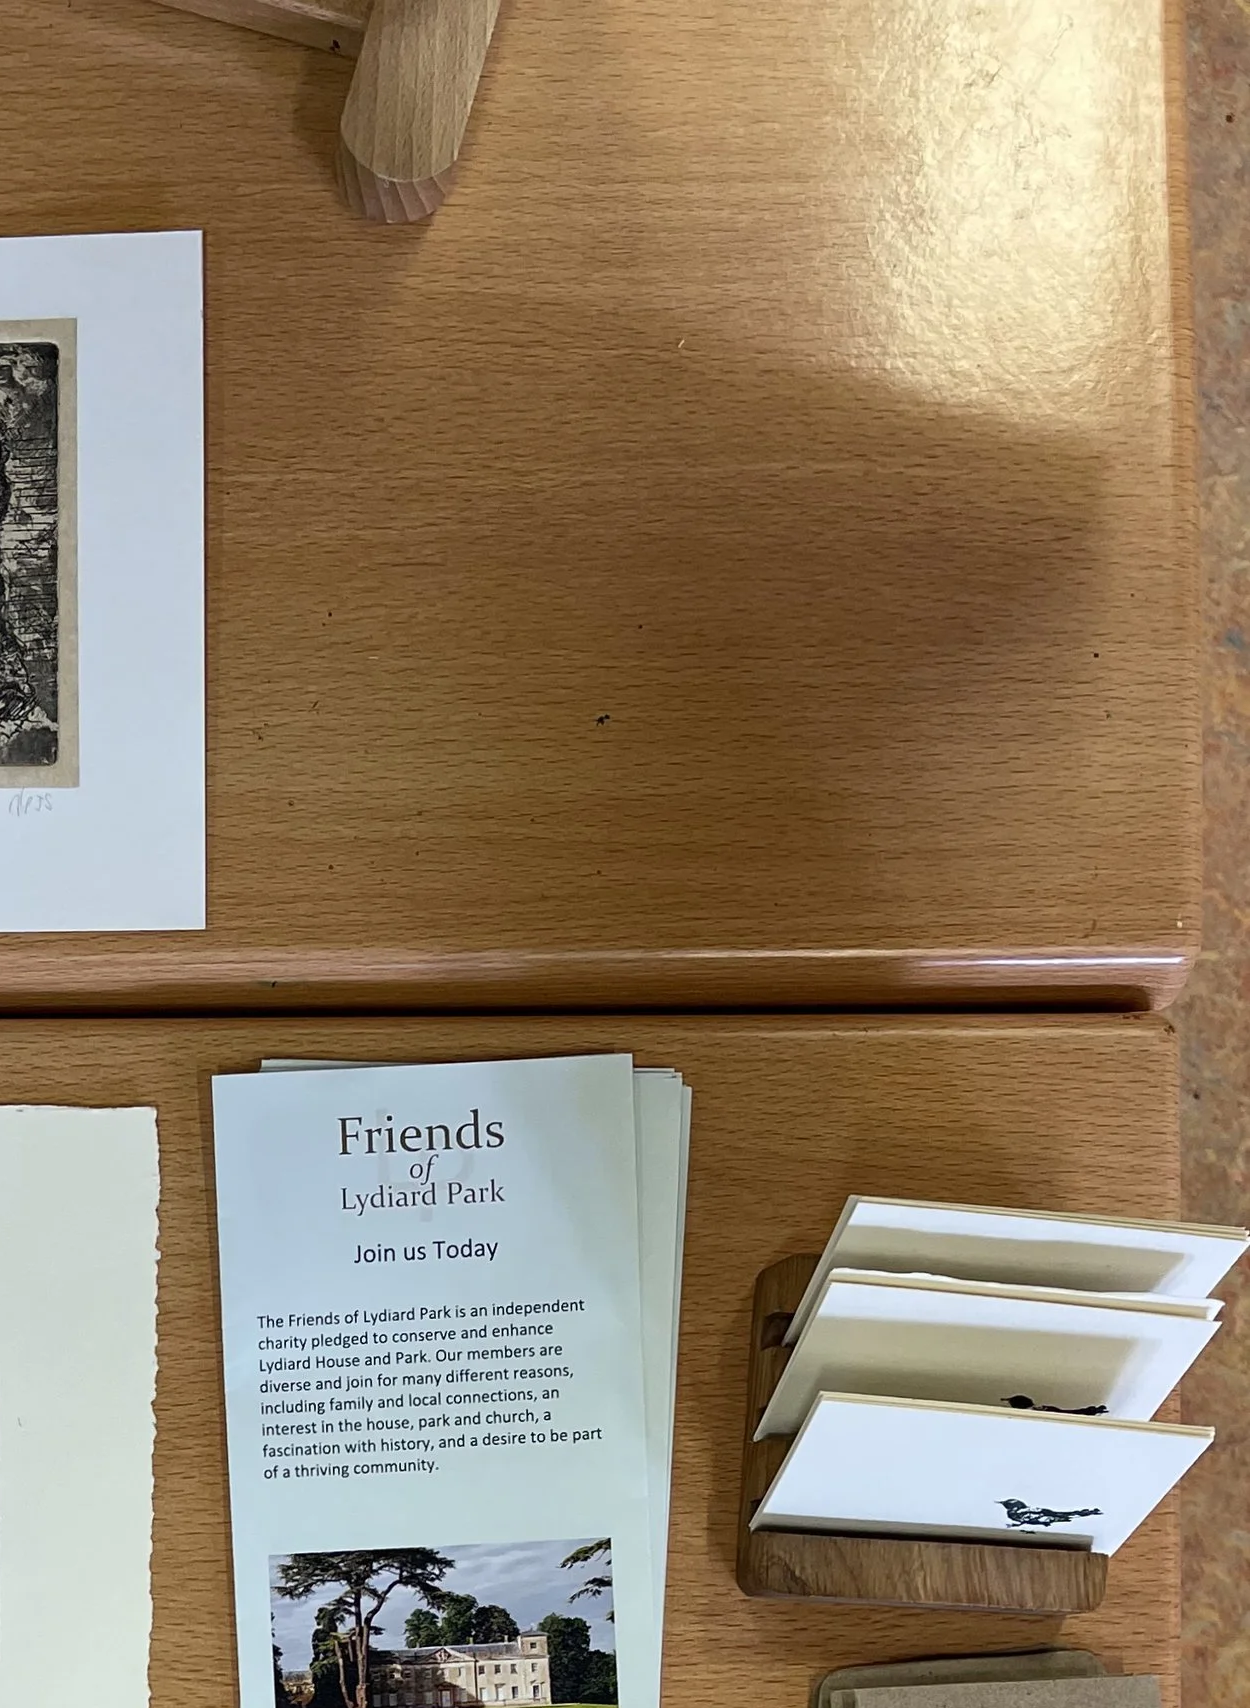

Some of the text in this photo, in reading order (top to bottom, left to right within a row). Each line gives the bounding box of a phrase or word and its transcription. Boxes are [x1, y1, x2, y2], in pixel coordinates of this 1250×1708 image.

[336, 1108, 505, 1156] Friends
[409, 1154, 439, 1185] of
[340, 1179, 505, 1215] Lydiard Park
[354, 1238, 499, 1264] Join us Today
[257, 1298, 585, 1329] The Friends of Lydiard Park is an independent
[259, 1344, 563, 1372] Lydiard House and Park. Our members are
[259, 1365, 574, 1394] diverse and join for many different reasons,
[260, 1387, 560, 1415] including family and local connections, an
[261, 1407, 551, 1437] interest in the house, park and church, a
[262, 1427, 602, 1458] fascination with history, and a desire to be part
